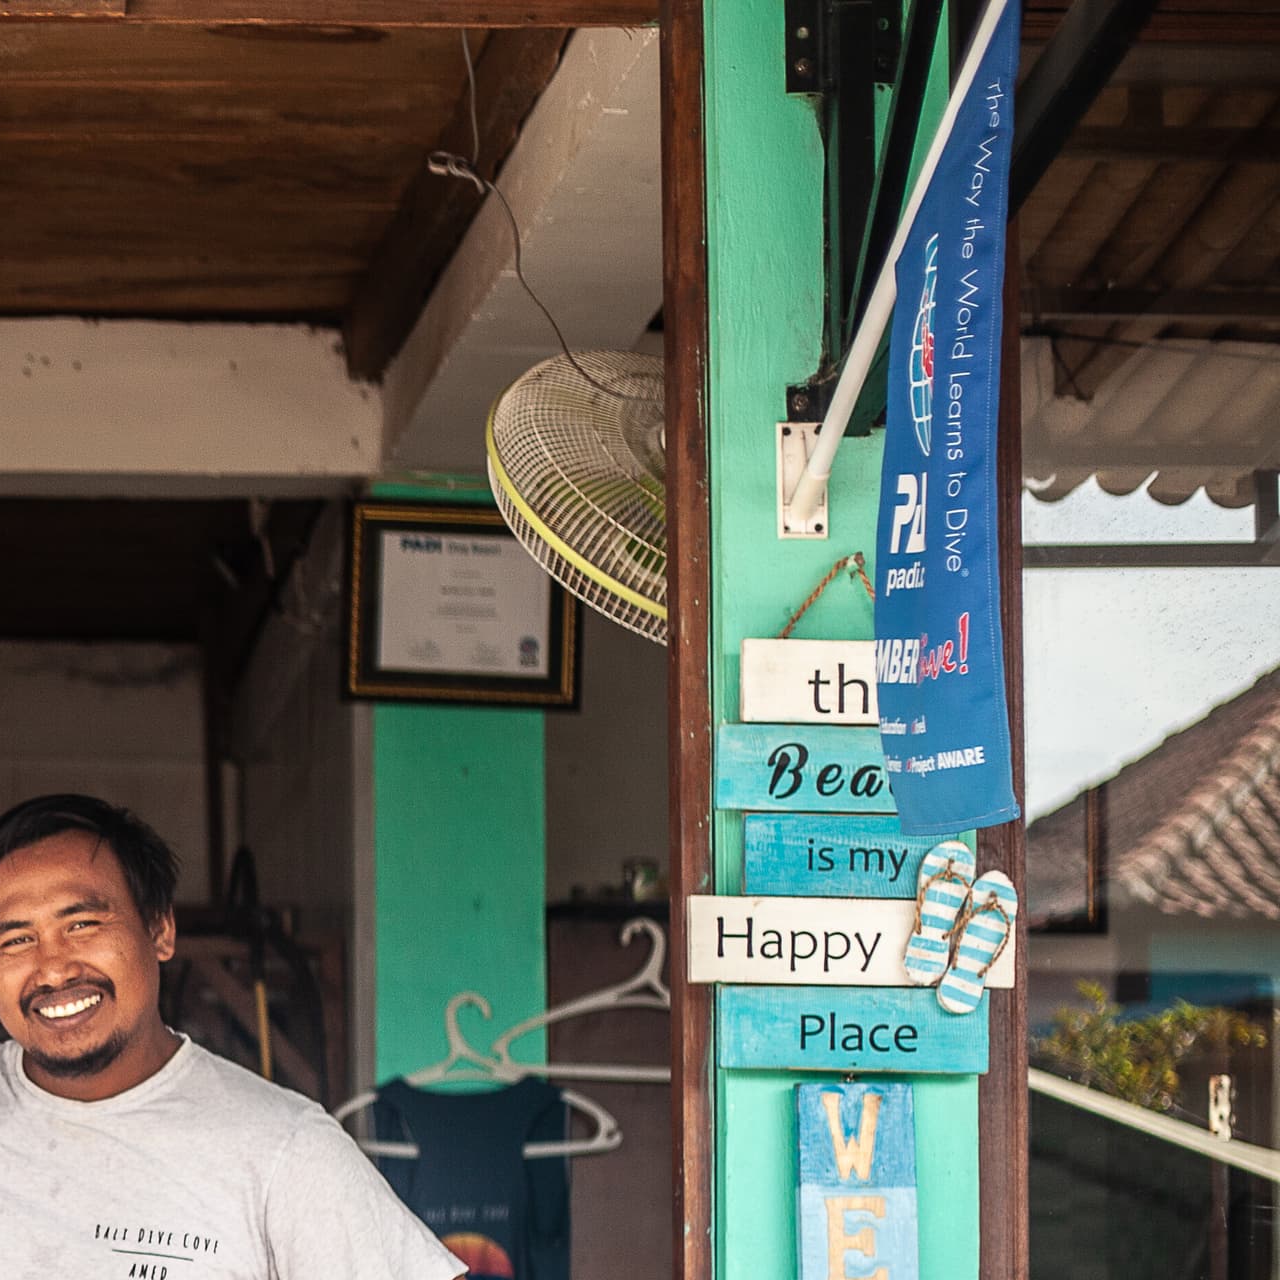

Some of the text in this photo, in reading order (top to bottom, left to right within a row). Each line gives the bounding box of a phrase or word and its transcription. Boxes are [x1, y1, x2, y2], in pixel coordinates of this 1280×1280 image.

[986, 75, 1005, 128] The
[965, 134, 998, 207] Way
[961, 217, 985, 259] the
[951, 268, 980, 359] World
[945, 372, 971, 462] Learns
[946, 471, 969, 498] to
[807, 662, 872, 716] th
[767, 742, 892, 800] Bea
[938, 745, 986, 771] AWARE
[806, 838, 909, 882] is my
[715, 916, 883, 973] Happy
[799, 1011, 919, 1053] Place
[94, 1223, 220, 1255] BALI DIVE COVE
[128, 1262, 168, 1280] AMED
